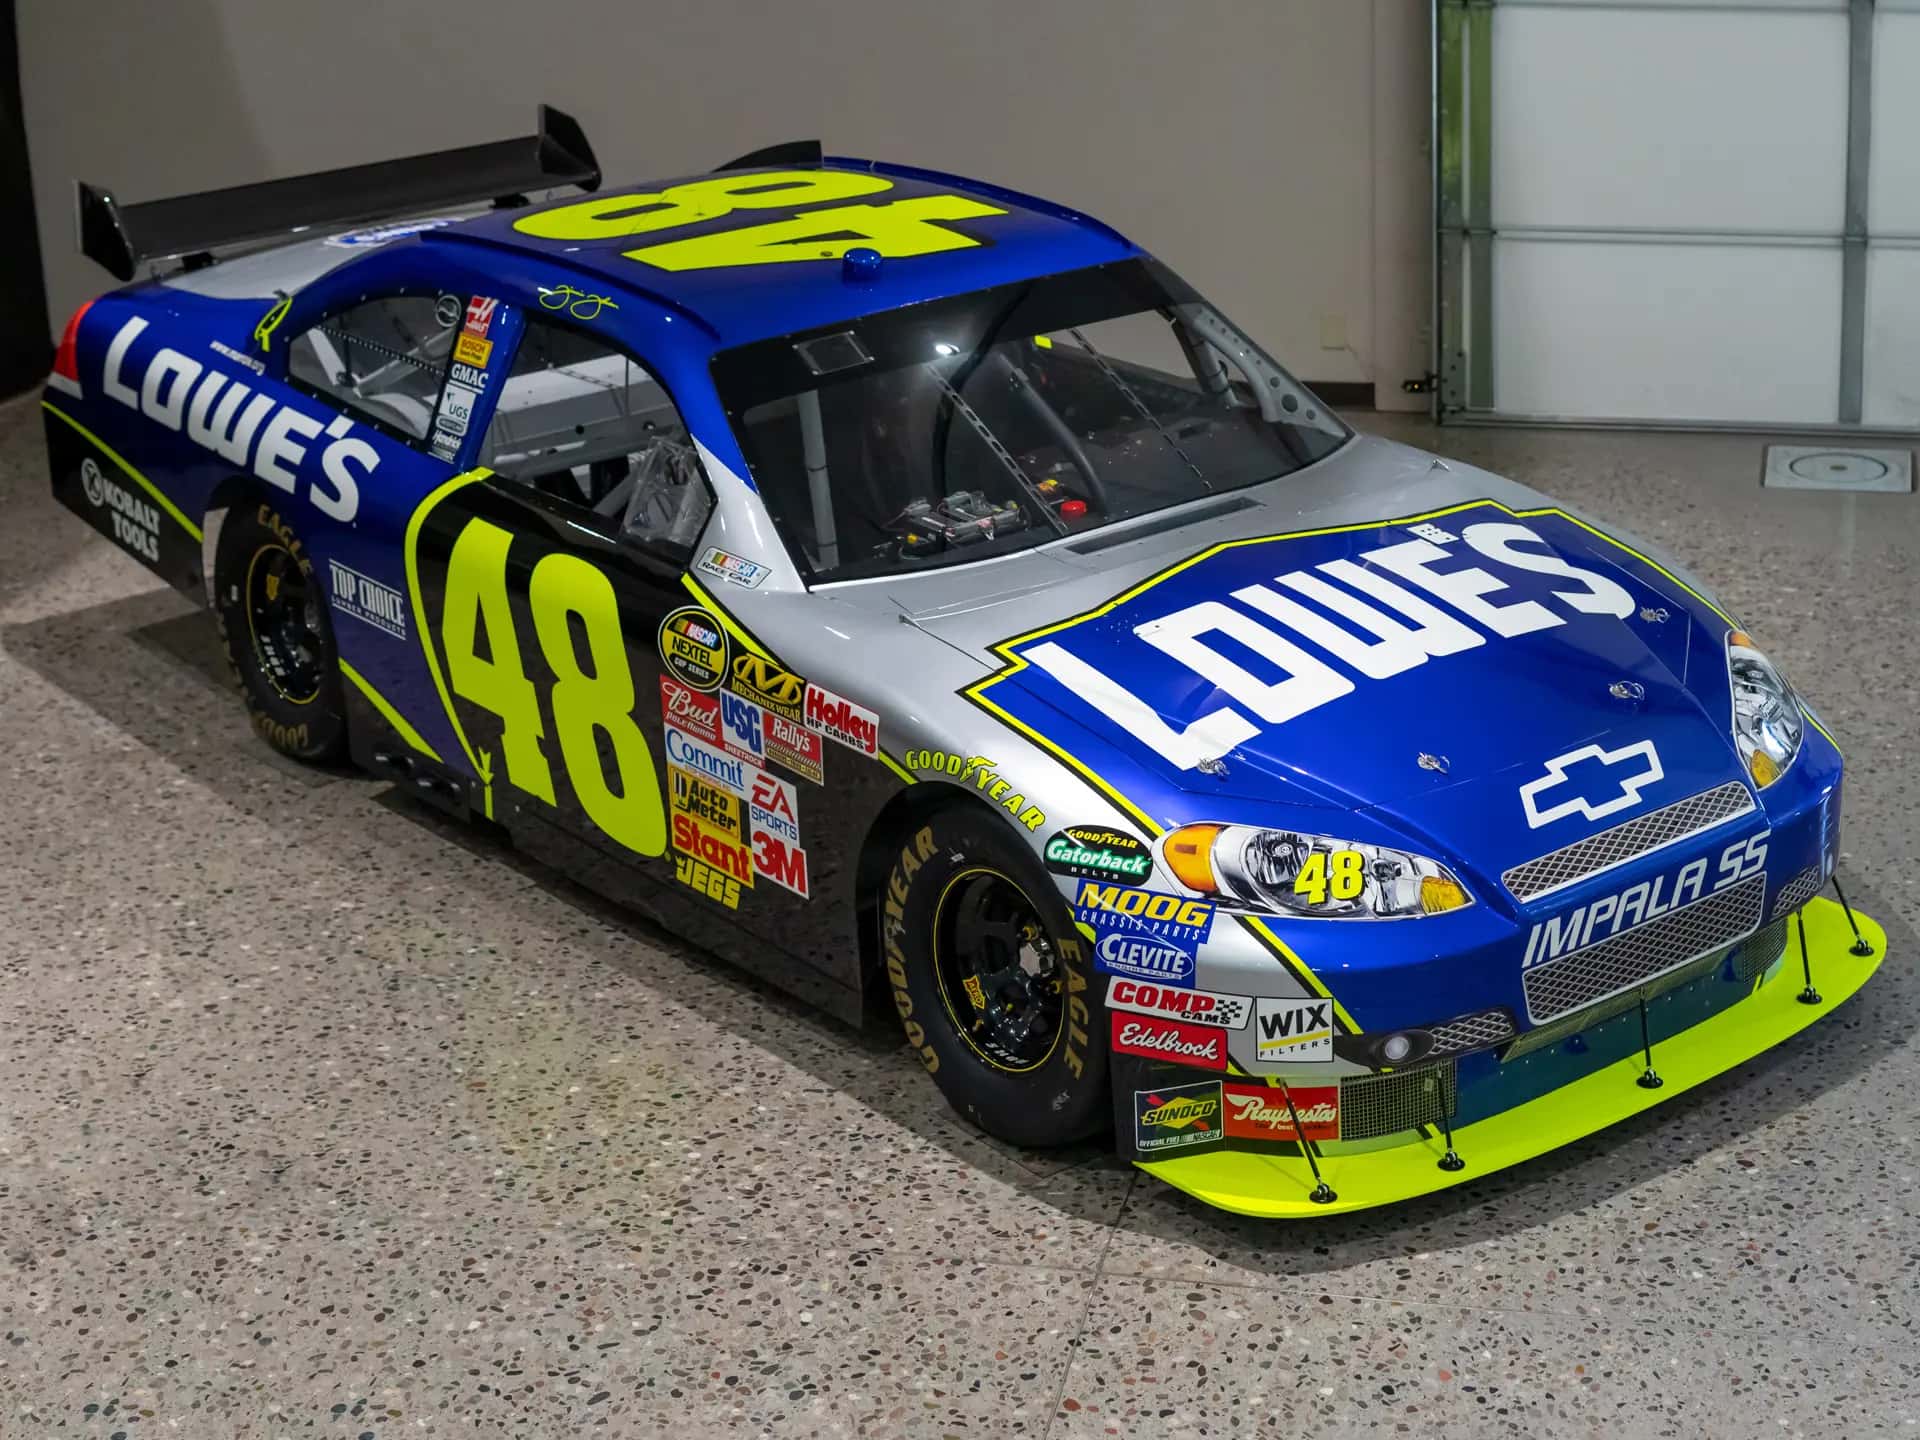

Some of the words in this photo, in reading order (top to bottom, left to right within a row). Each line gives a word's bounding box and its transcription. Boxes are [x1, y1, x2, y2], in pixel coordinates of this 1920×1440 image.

[451, 363, 489, 388] GMAC
[103, 315, 381, 523] LOWE'S
[449, 402, 469, 420] UGS
[103, 478, 160, 536] KOBALT
[112, 511, 160, 562] TOOLS
[702, 561, 724, 575] RACE
[729, 572, 752, 585] CAR
[329, 563, 356, 603] TOP
[358, 579, 406, 628] CHOICE
[672, 635, 713, 668] NEXTEL
[686, 622, 718, 648] NASCAR
[1021, 523, 1636, 771] LOWE'S
[442, 517, 667, 858] 48
[687, 663, 710, 680] SERIES
[662, 682, 718, 727] Bud
[731, 677, 776, 712] MECHANIX
[775, 703, 801, 723] WEAR
[721, 692, 763, 755] USG
[772, 718, 811, 753] Rally's
[807, 687, 876, 754] Holley
[807, 716, 823, 730] HP
[824, 724, 866, 750] CARBS
[667, 728, 744, 788] Commit
[690, 780, 729, 811] Auto
[751, 773, 796, 825] EA
[905, 749, 1046, 832] GOODYEAR
[687, 796, 737, 831] Meter
[751, 805, 798, 841] SPORTS
[673, 813, 751, 882] Stant
[1047, 839, 1146, 875] Gatorback
[1067, 829, 1138, 849] GOODYEAR
[752, 830, 807, 894] 3M
[1071, 866, 1119, 880] BELTS
[1293, 849, 1364, 905] 48
[676, 855, 741, 911] JEGS
[1521, 857, 1708, 968] IMPALA
[1713, 829, 1772, 889] SS
[1077, 882, 1213, 928] MOOG
[1081, 909, 1144, 931] CHASSIS
[1151, 921, 1200, 941] PARTS
[1101, 933, 1186, 973] CLEVITE
[1056, 938, 1089, 1081] EAGLE
[1112, 981, 1216, 1013] COMP
[1180, 1009, 1231, 1026] CAMS
[1259, 1003, 1330, 1040] WIX
[1119, 1022, 1219, 1061] Edelbrock
[1259, 1038, 1331, 1059] FILTERS
[1143, 1101, 1215, 1126] SUNOCO
